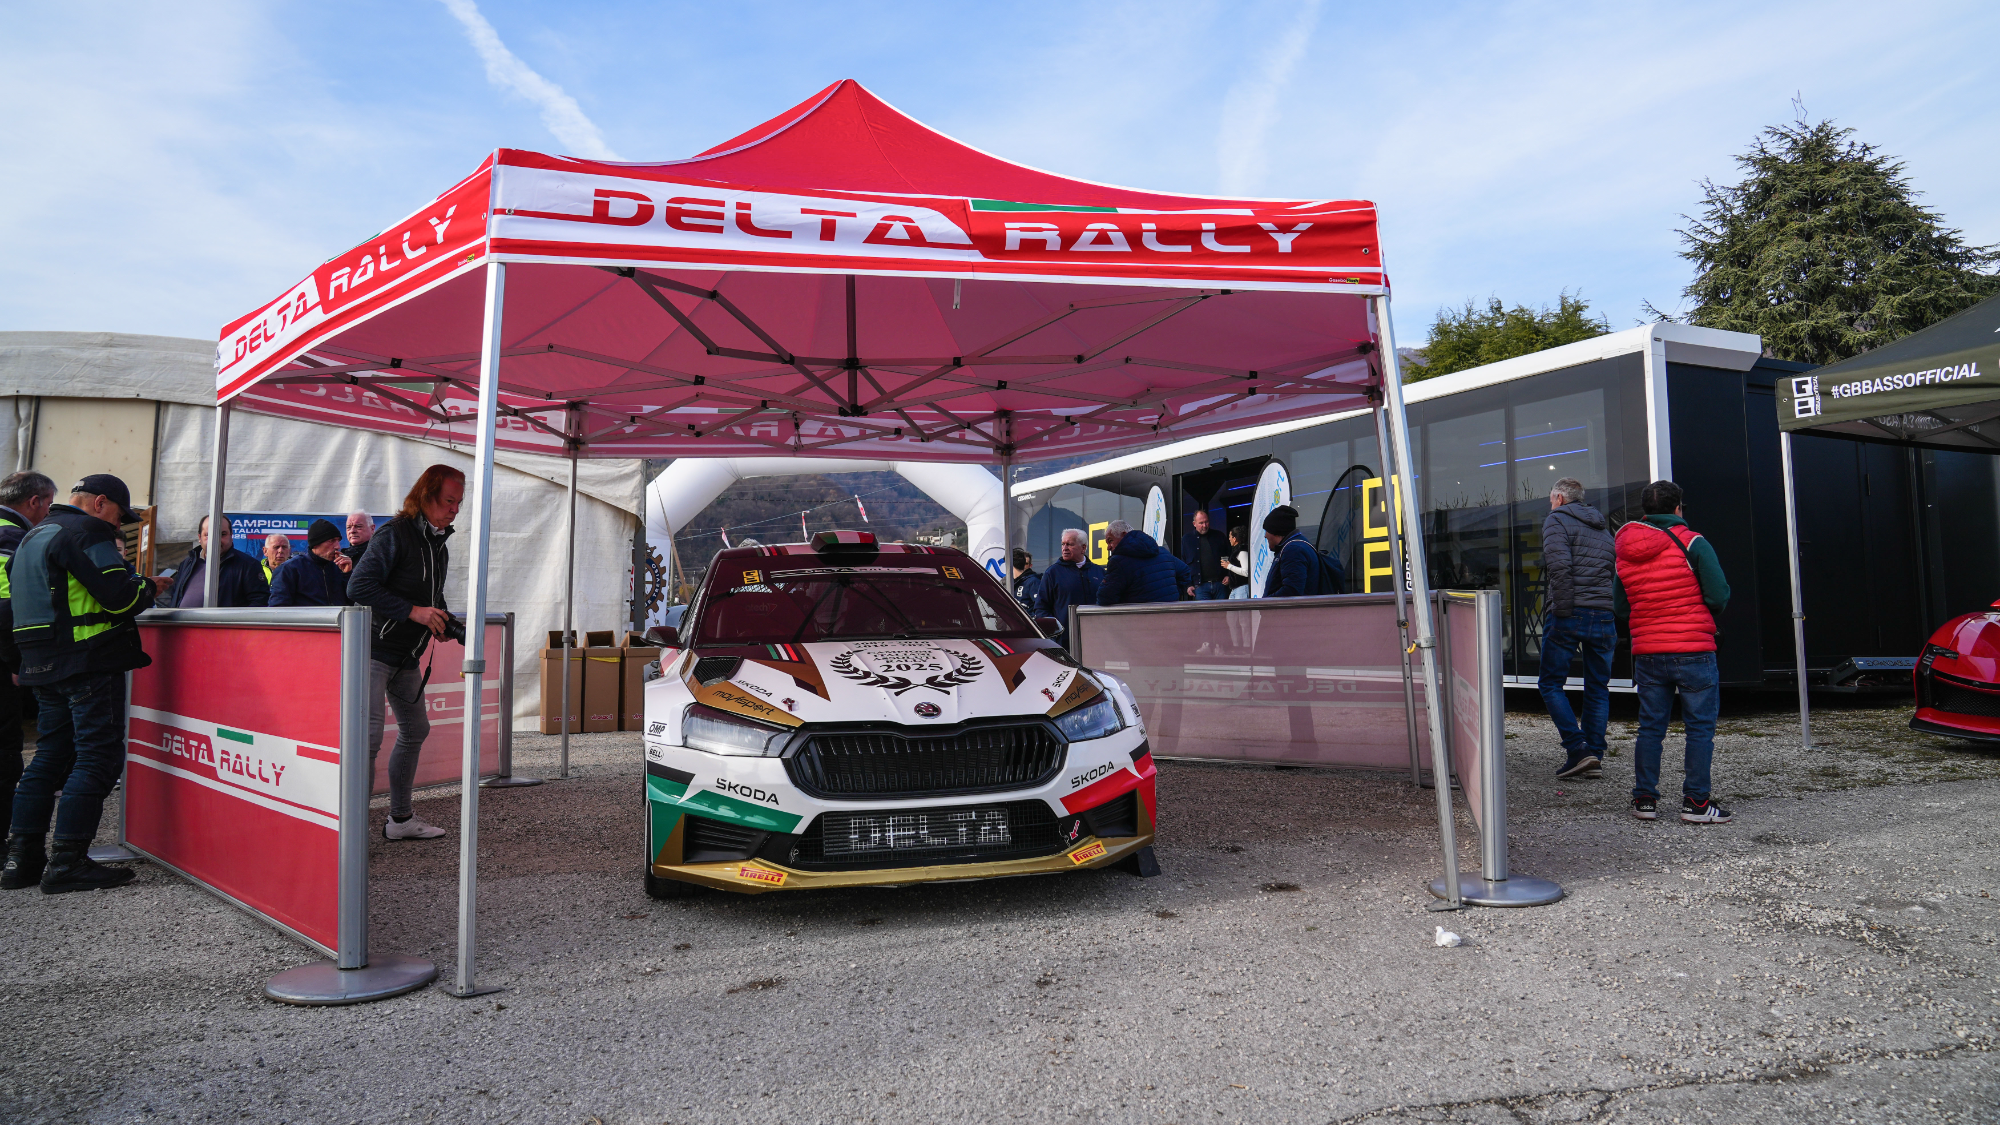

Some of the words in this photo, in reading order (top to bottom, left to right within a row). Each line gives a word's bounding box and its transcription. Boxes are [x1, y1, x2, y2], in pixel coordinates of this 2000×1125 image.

[592, 188, 928, 245] DELTA
[1004, 222, 1314, 253] RALLY
[234, 291, 310, 362] DELTA
[328, 204, 458, 301] RALLY
[1831, 362, 1981, 399] #GBBASSOFFICIAL
[232, 519, 297, 528] AMPIONI
[879, 663, 943, 673] 2025
[712, 690, 776, 716] movsport
[648, 723, 666, 735] OMP
[162, 732, 211, 763] DELTA
[220, 749, 285, 786] RALLY
[649, 747, 662, 758] BELL
[849, 811, 1011, 850] DELTA
[1072, 843, 1104, 862] PIRELLI
[739, 866, 784, 883] PIRELLI
